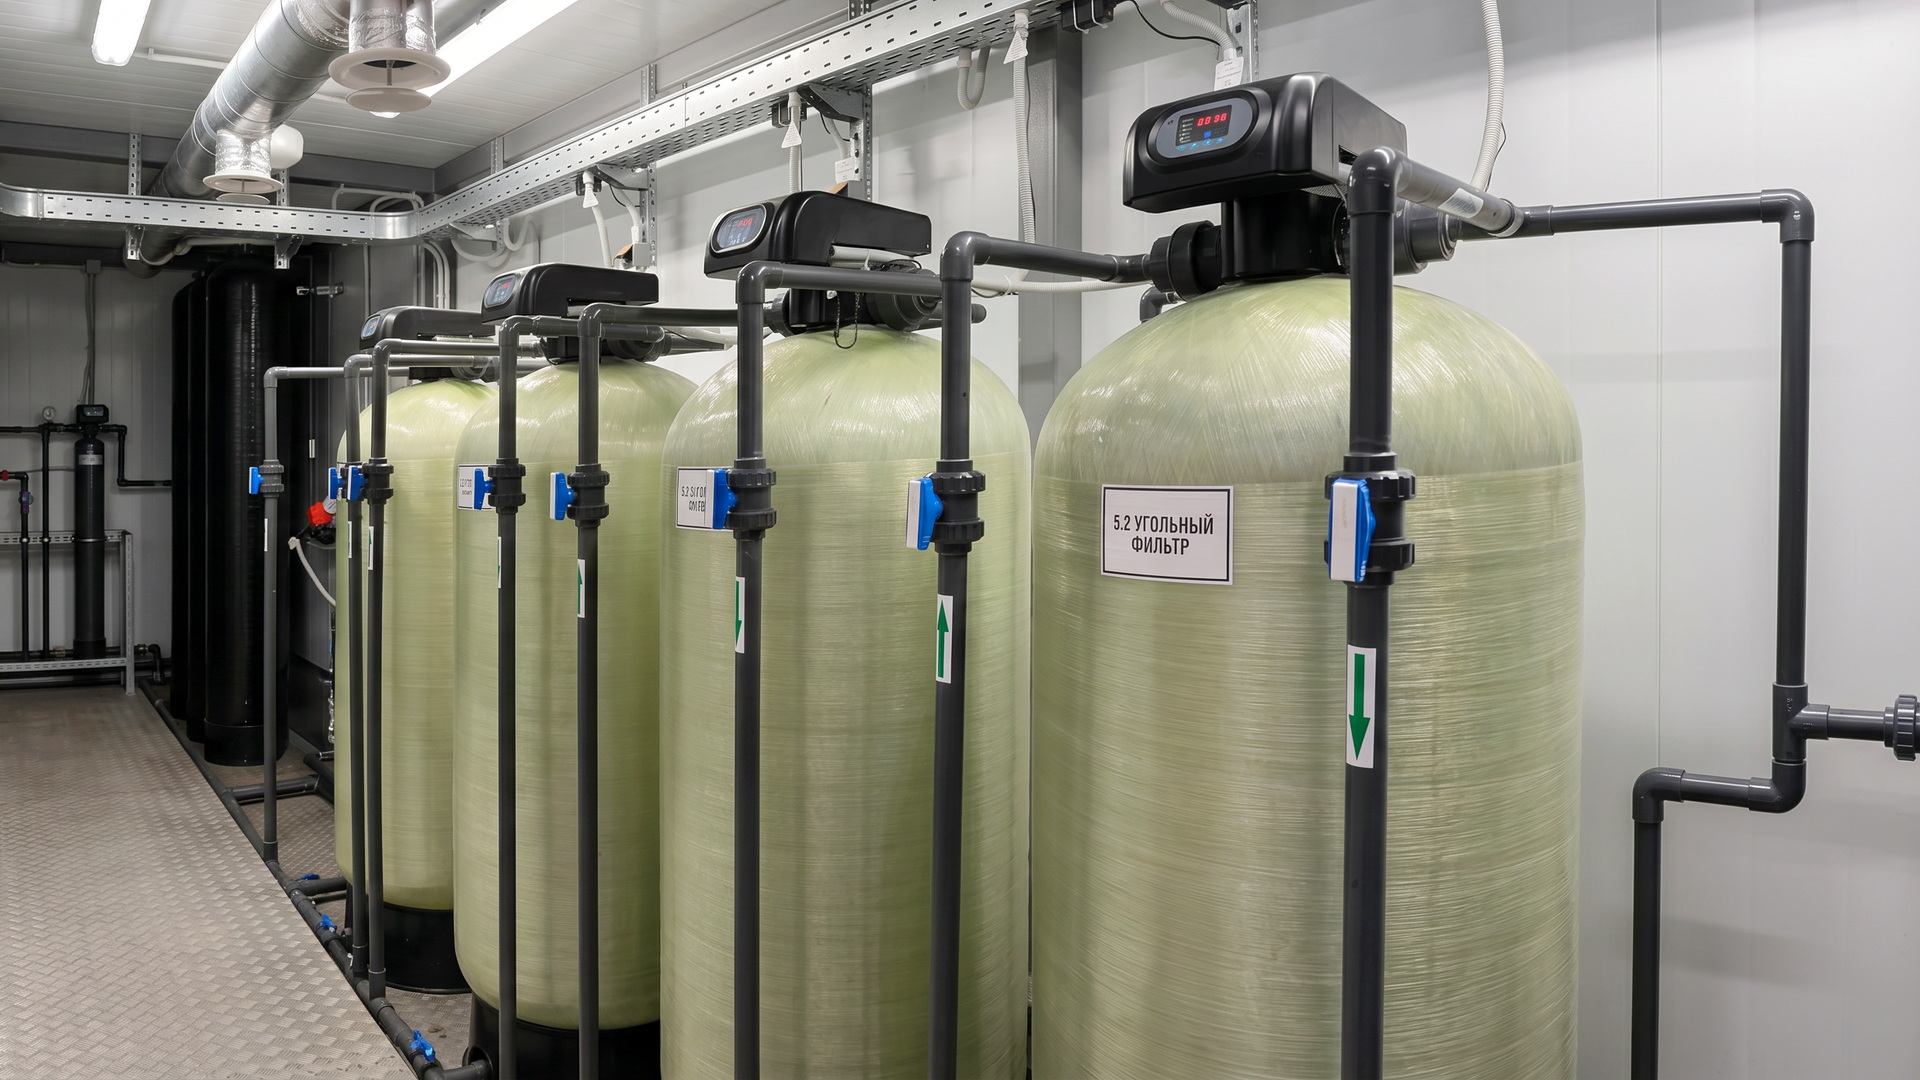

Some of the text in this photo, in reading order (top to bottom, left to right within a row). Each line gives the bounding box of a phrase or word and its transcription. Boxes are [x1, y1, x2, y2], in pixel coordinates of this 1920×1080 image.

[1113, 513, 1214, 535] 5.2 УГОЛЬНЫЙ
[1131, 536, 1190, 555] ФИЛЬТР
